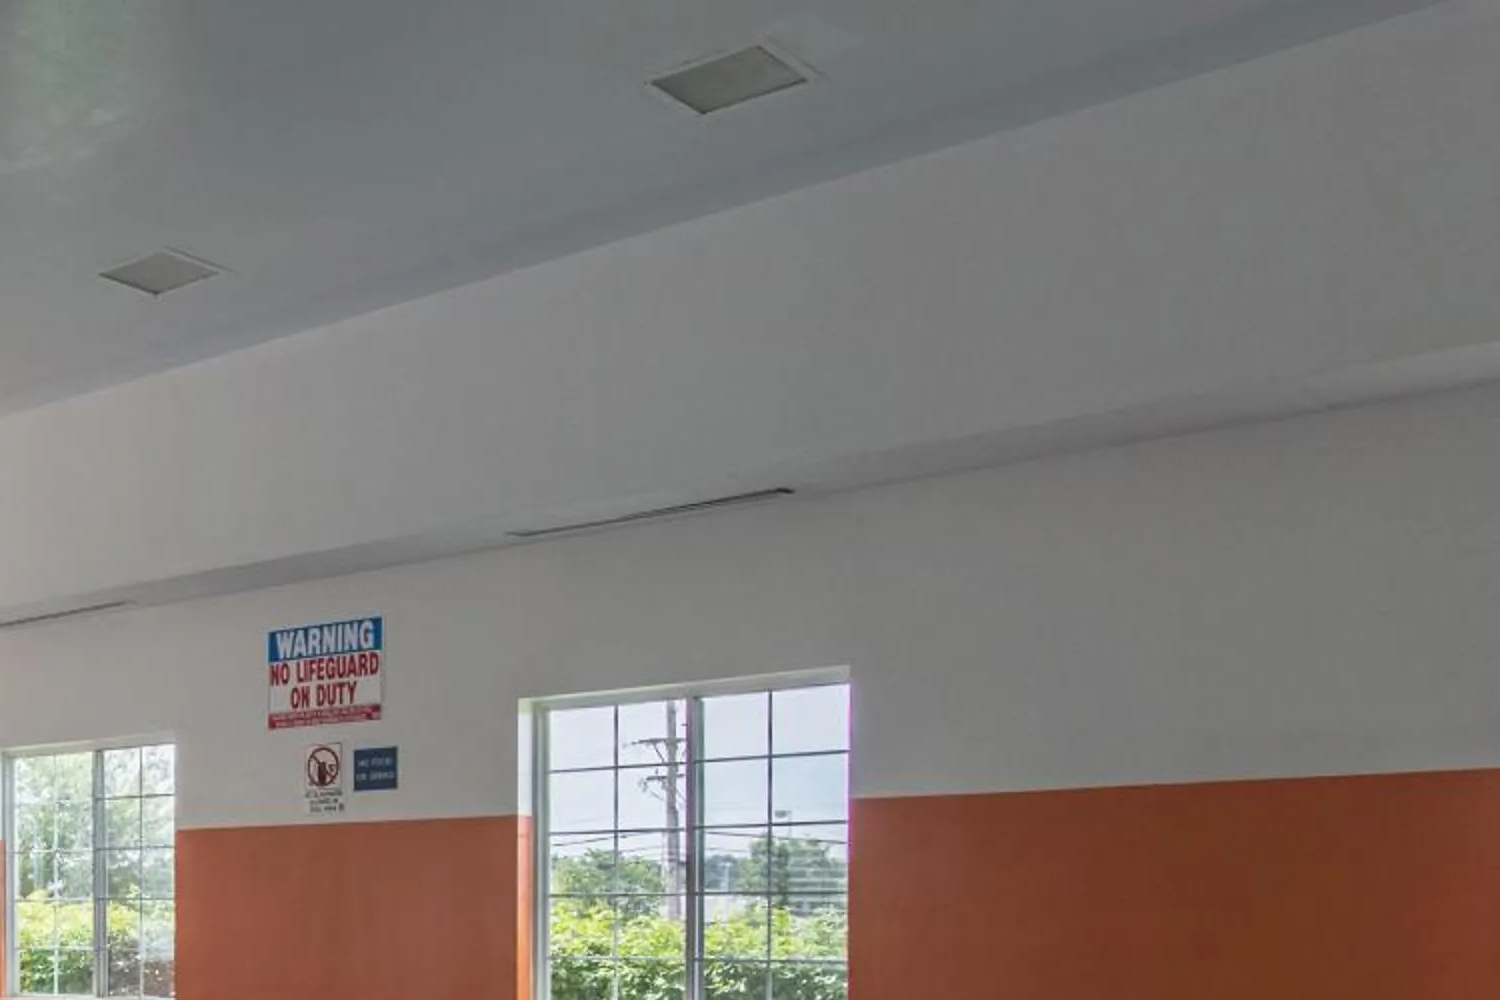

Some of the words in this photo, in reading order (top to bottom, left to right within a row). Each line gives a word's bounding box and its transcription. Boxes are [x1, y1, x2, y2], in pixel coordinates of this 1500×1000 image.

[276, 620, 374, 659] WARNING
[270, 662, 290, 687] NO
[296, 652, 379, 683] LIFEGUARD
[291, 687, 310, 709] ON
[316, 681, 356, 706] DUTY
